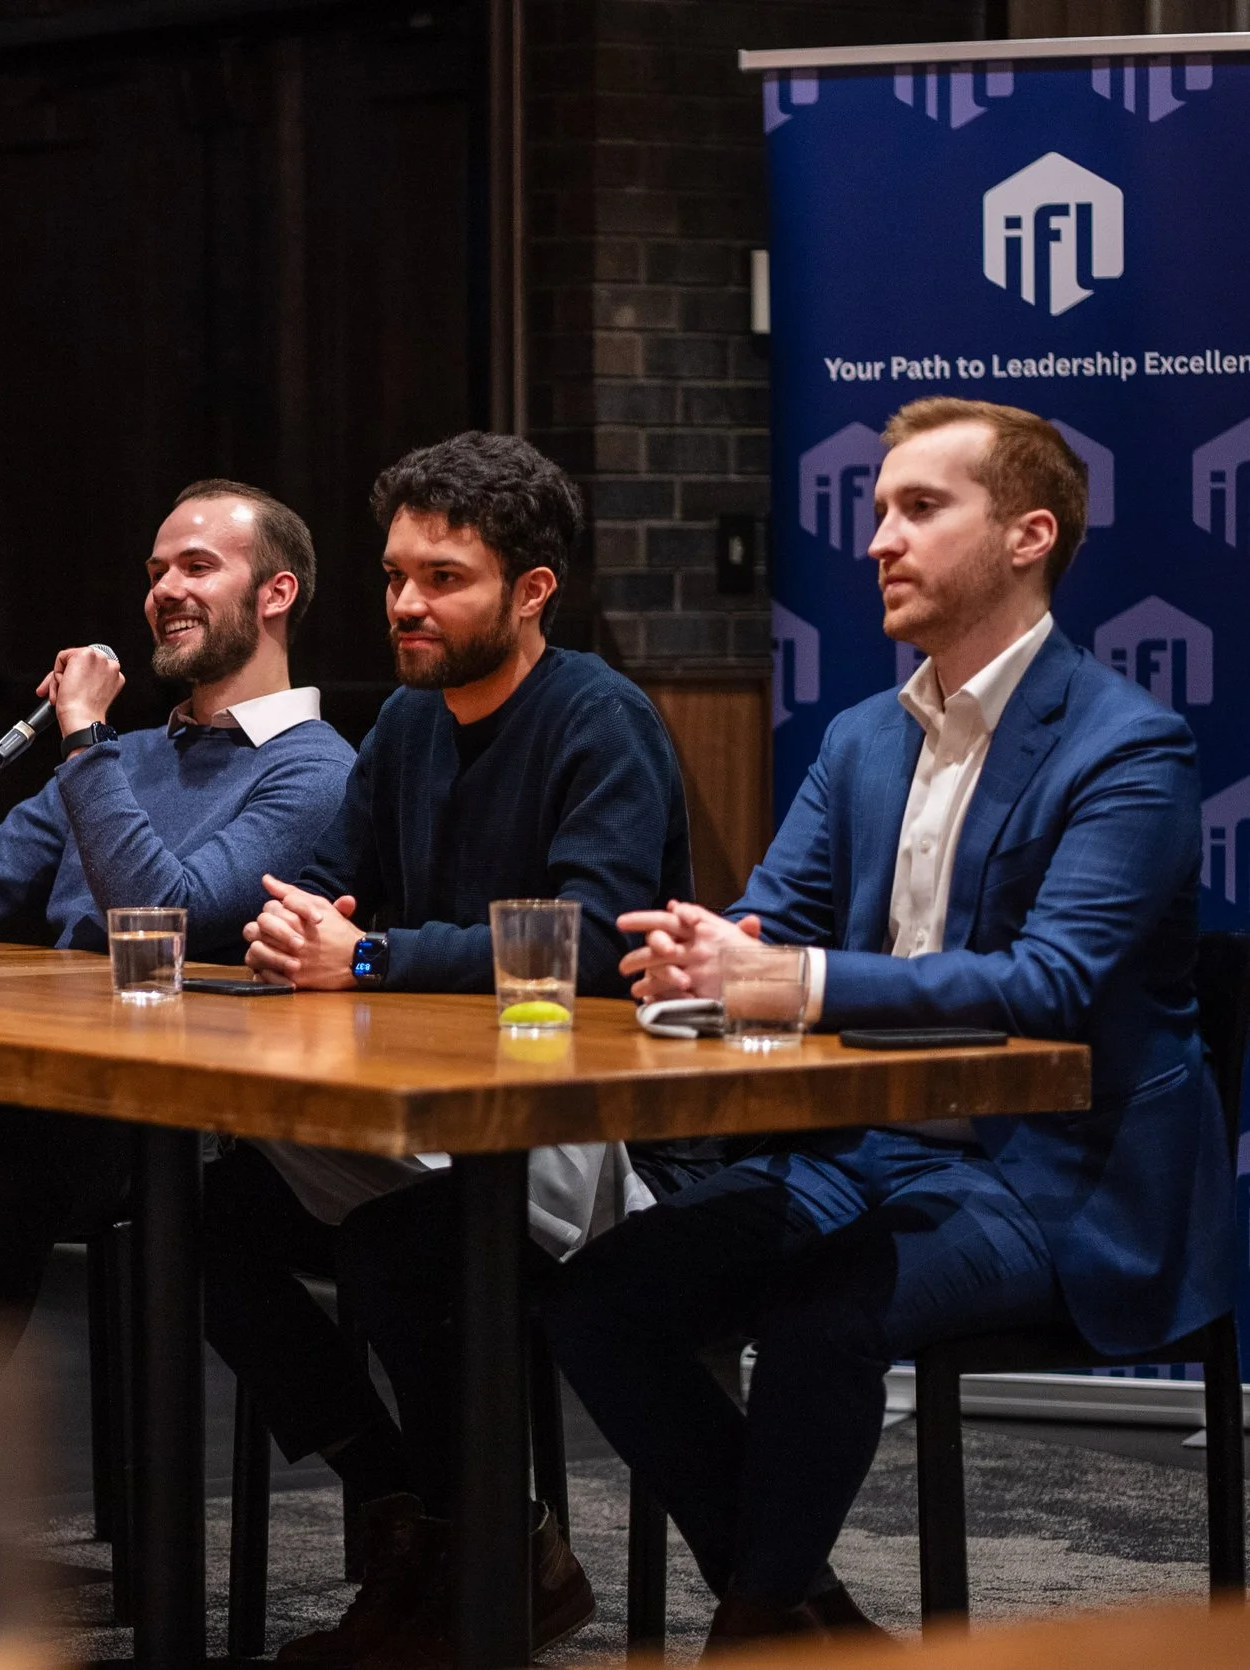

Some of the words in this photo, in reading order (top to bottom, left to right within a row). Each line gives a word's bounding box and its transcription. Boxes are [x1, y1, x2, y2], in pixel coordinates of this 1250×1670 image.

[823, 356, 885, 382] Your
[890, 354, 950, 380] Path
[955, 356, 985, 379] to
[992, 351, 1137, 382] Leadership
